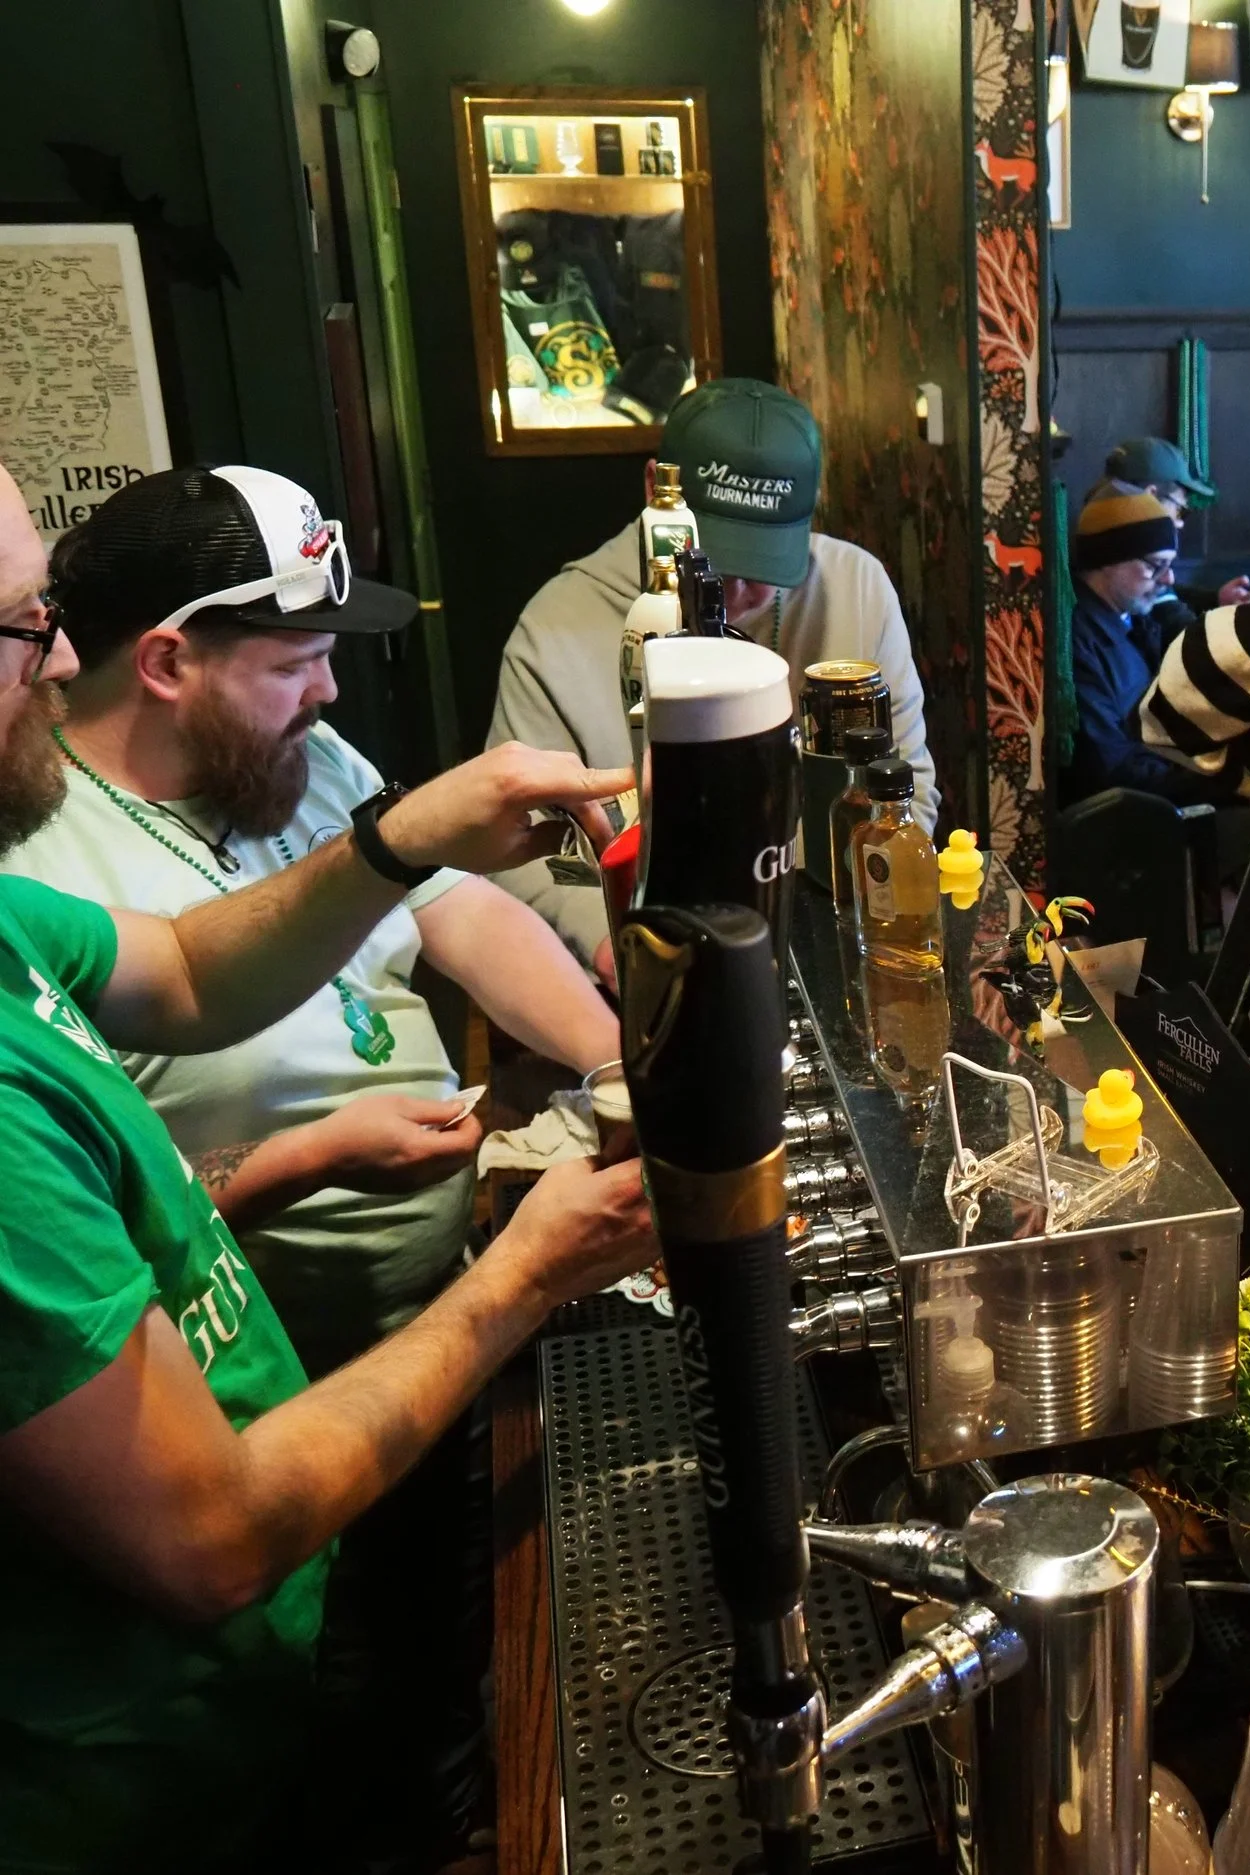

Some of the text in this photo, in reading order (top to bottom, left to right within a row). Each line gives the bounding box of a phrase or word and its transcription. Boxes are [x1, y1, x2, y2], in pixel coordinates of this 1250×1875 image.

[698, 460, 794, 494] MASTERS
[706, 483, 782, 511] TOURNAMENT
[1158, 1011, 1221, 1065] FERCULLEN
[1179, 1044, 1213, 1074] FALLS
[1175, 1071, 1207, 1094] WHISKEY
